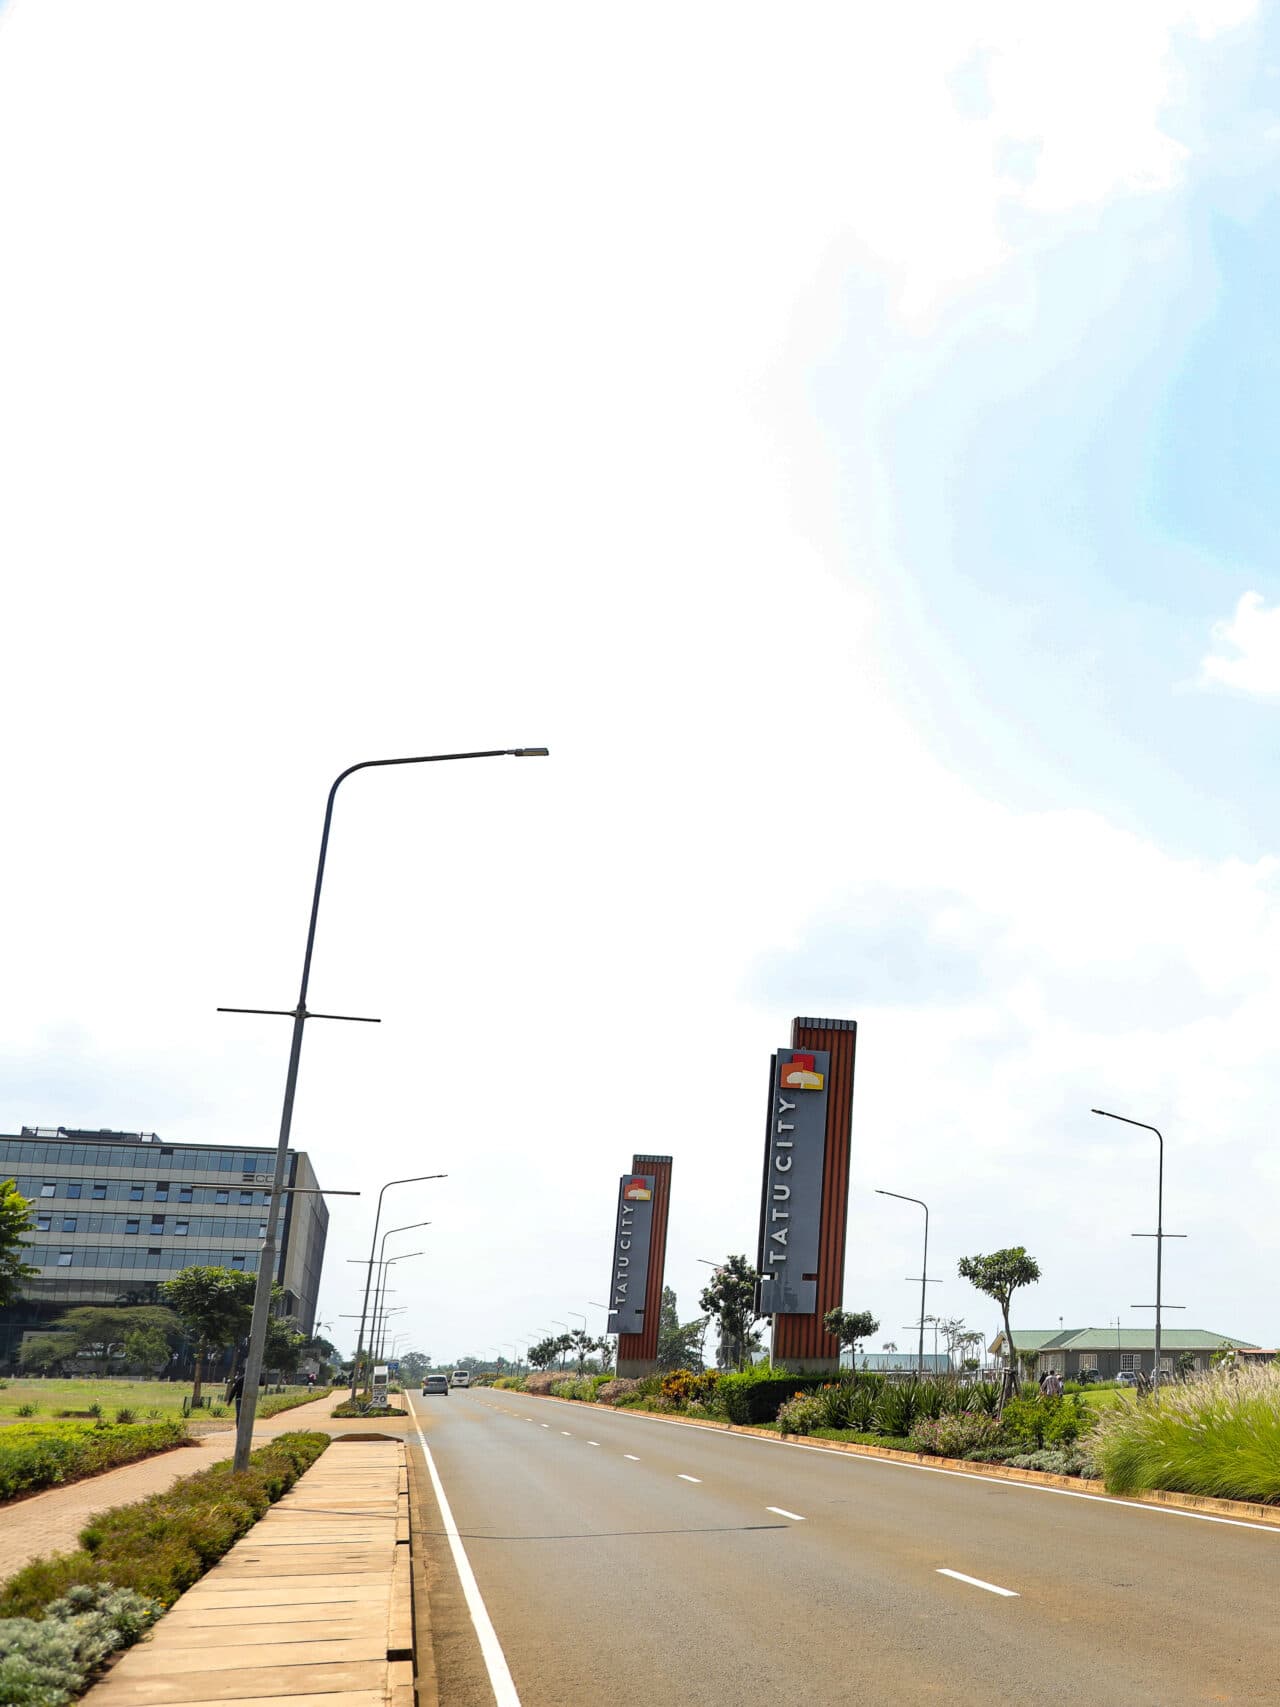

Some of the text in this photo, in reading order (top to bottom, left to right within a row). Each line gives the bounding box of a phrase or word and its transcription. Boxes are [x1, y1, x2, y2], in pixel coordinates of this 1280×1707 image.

[769, 1098, 796, 1264] TATU CITY
[615, 1205, 634, 1304] TATU CITY
